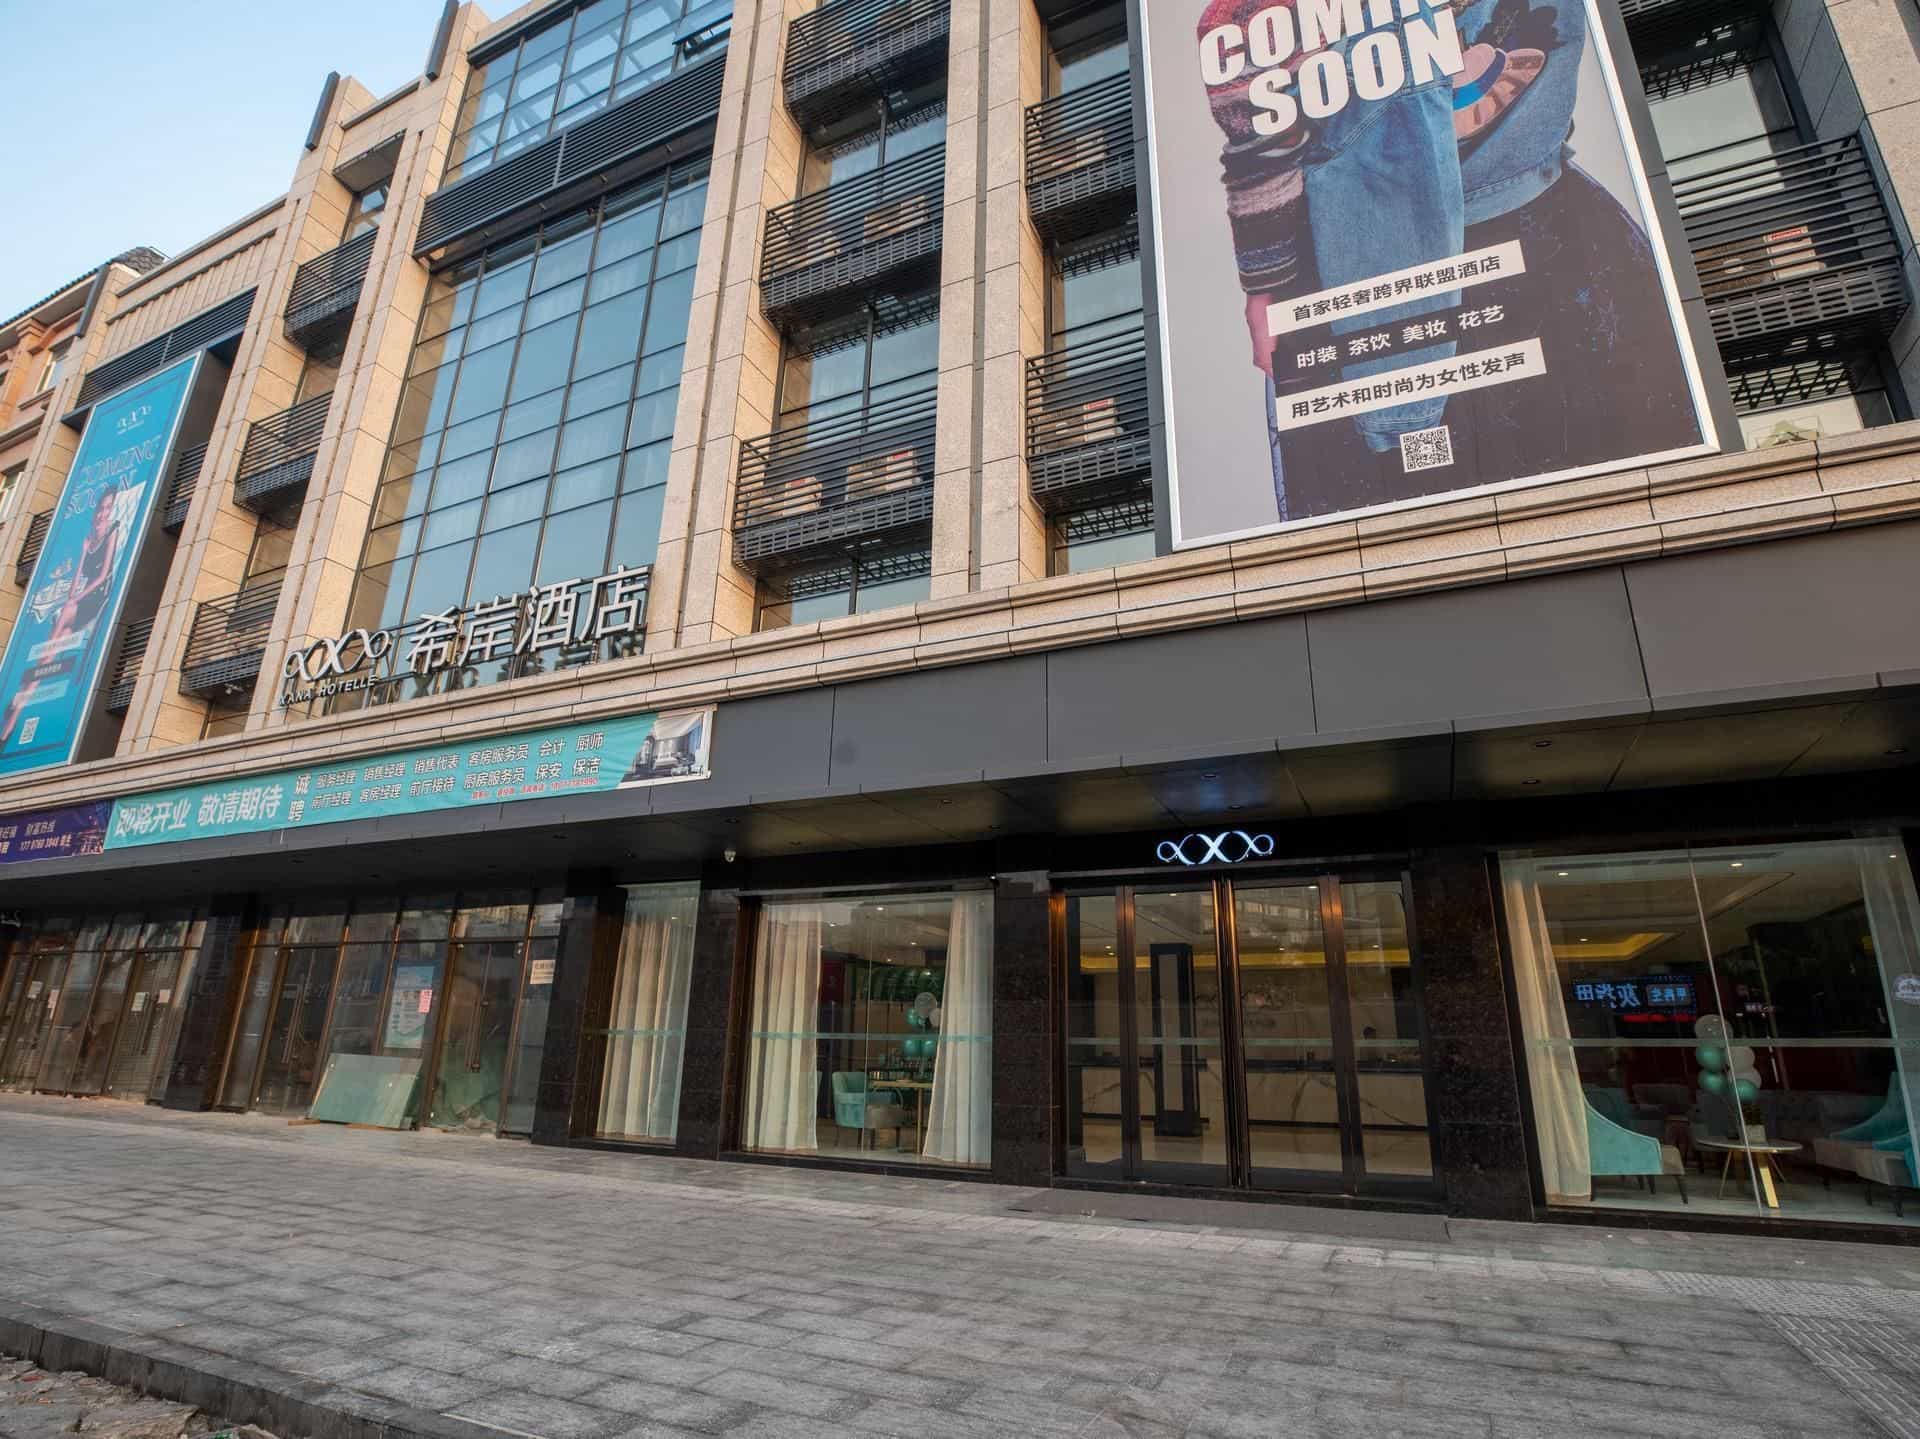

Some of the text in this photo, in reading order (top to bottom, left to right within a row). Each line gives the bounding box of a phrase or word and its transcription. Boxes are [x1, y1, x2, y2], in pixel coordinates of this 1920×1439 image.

[1249, 7, 1465, 136] SOON
[1293, 255, 1501, 322] 首家轻奢跨界联盟酒店
[1297, 304, 1505, 369] 时装 茶饮 美妆 花艺
[1292, 352, 1526, 419] 用艺术和时尚为女性发声
[405, 563, 653, 675] 希岸酒店
[319, 675, 376, 697] HOTELLE
[409, 776, 456, 796] 前厅接待
[535, 762, 563, 781] 保安
[572, 757, 601, 777] 保洁
[414, 754, 460, 774] 销售代表
[539, 738, 566, 757] 会计
[576, 732, 604, 751] 厨师
[115, 784, 283, 837] 即将开业 敬请期待
